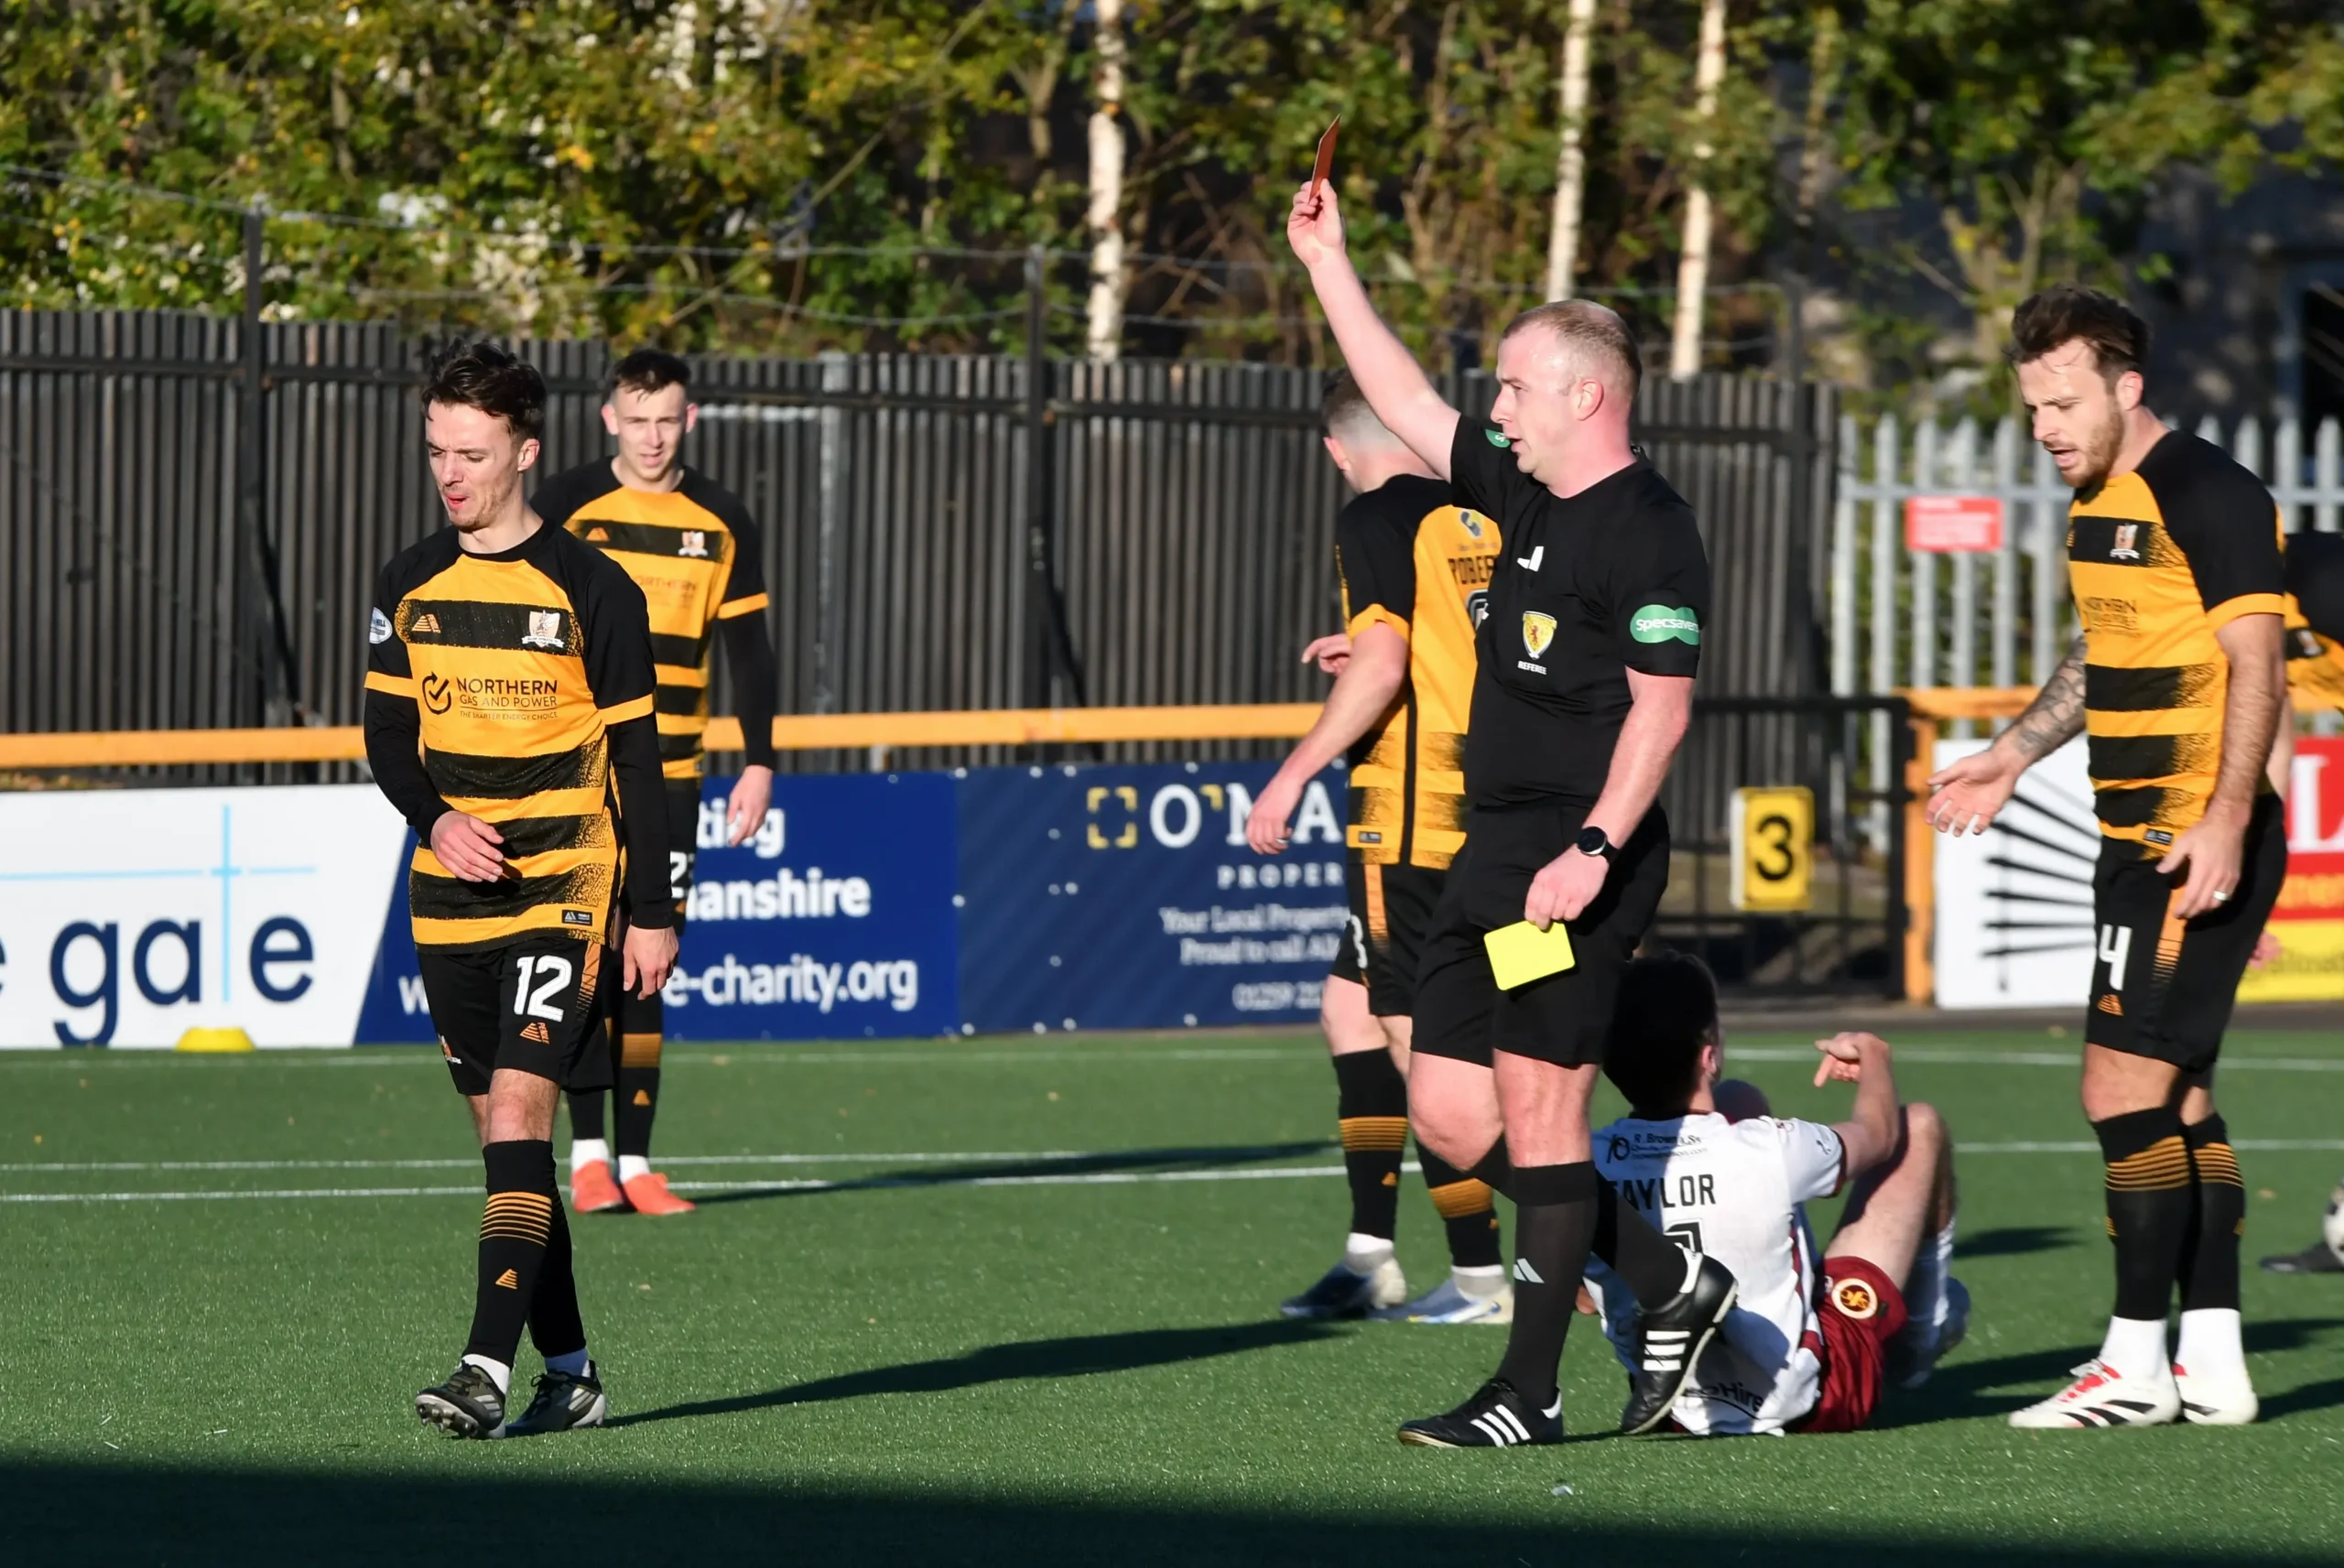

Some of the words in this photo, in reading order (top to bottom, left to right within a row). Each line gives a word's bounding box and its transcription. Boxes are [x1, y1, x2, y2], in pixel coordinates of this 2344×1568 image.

[1517, 660, 1547, 676] REFEREE
[456, 676, 559, 696] NORTHERN
[460, 694, 479, 707] GAS
[482, 697, 510, 708] AND
[513, 696, 558, 708] POWER
[460, 709, 472, 719] THE
[531, 711, 558, 720] CHOICE
[1755, 815, 1794, 881] 3
[514, 955, 572, 1022] 12
